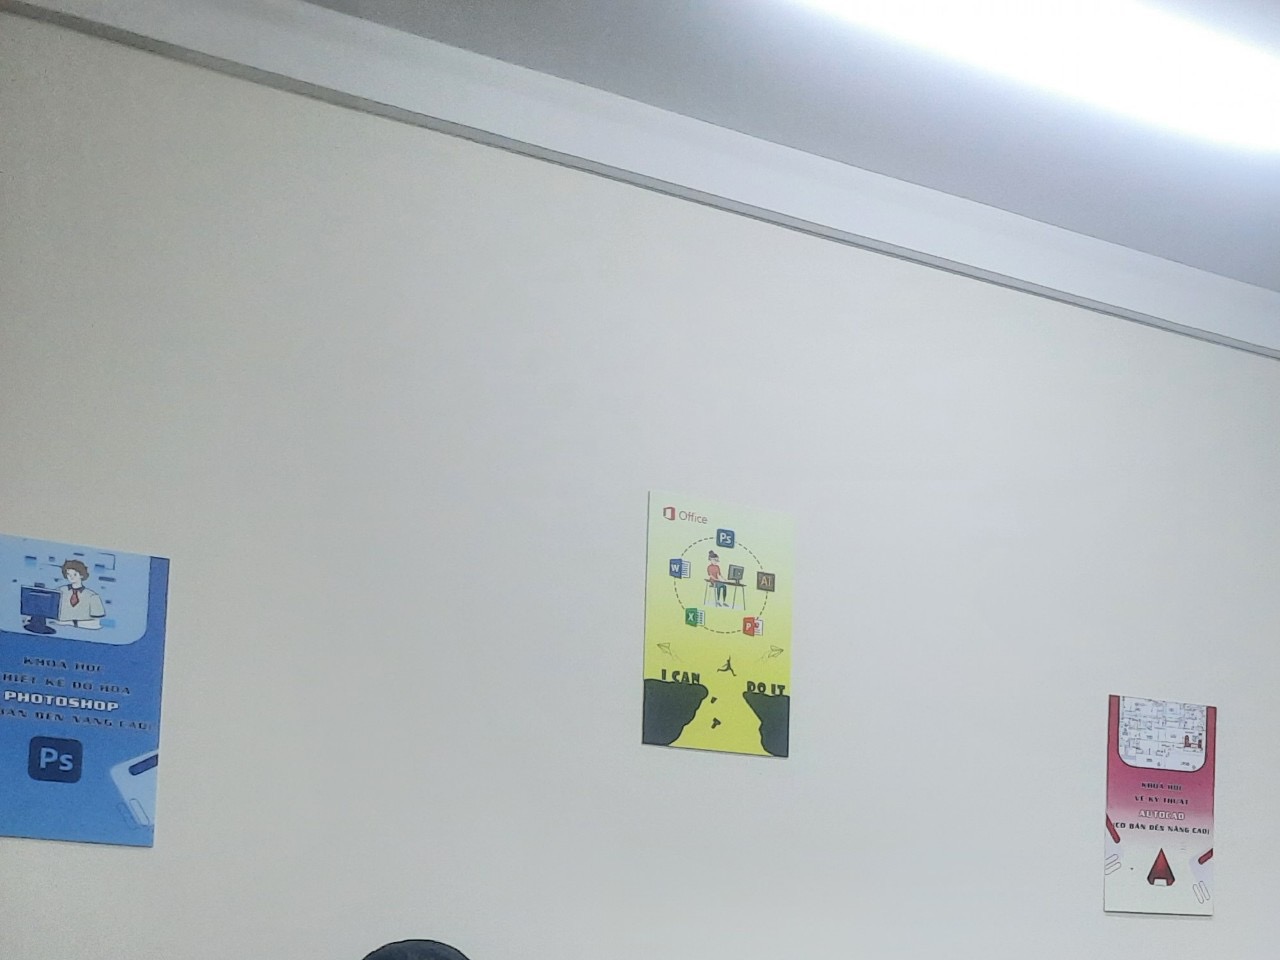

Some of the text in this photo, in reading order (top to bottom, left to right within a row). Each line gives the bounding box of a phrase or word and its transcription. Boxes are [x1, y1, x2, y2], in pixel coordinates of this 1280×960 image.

[678, 510, 708, 524] Office
[719, 532, 732, 544] Ps
[661, 668, 786, 696] I CAN DO IT
[4, 690, 120, 711] PHOTOSHOP
[39, 747, 74, 771] Ps
[1139, 810, 1185, 821] AUTOCAD
